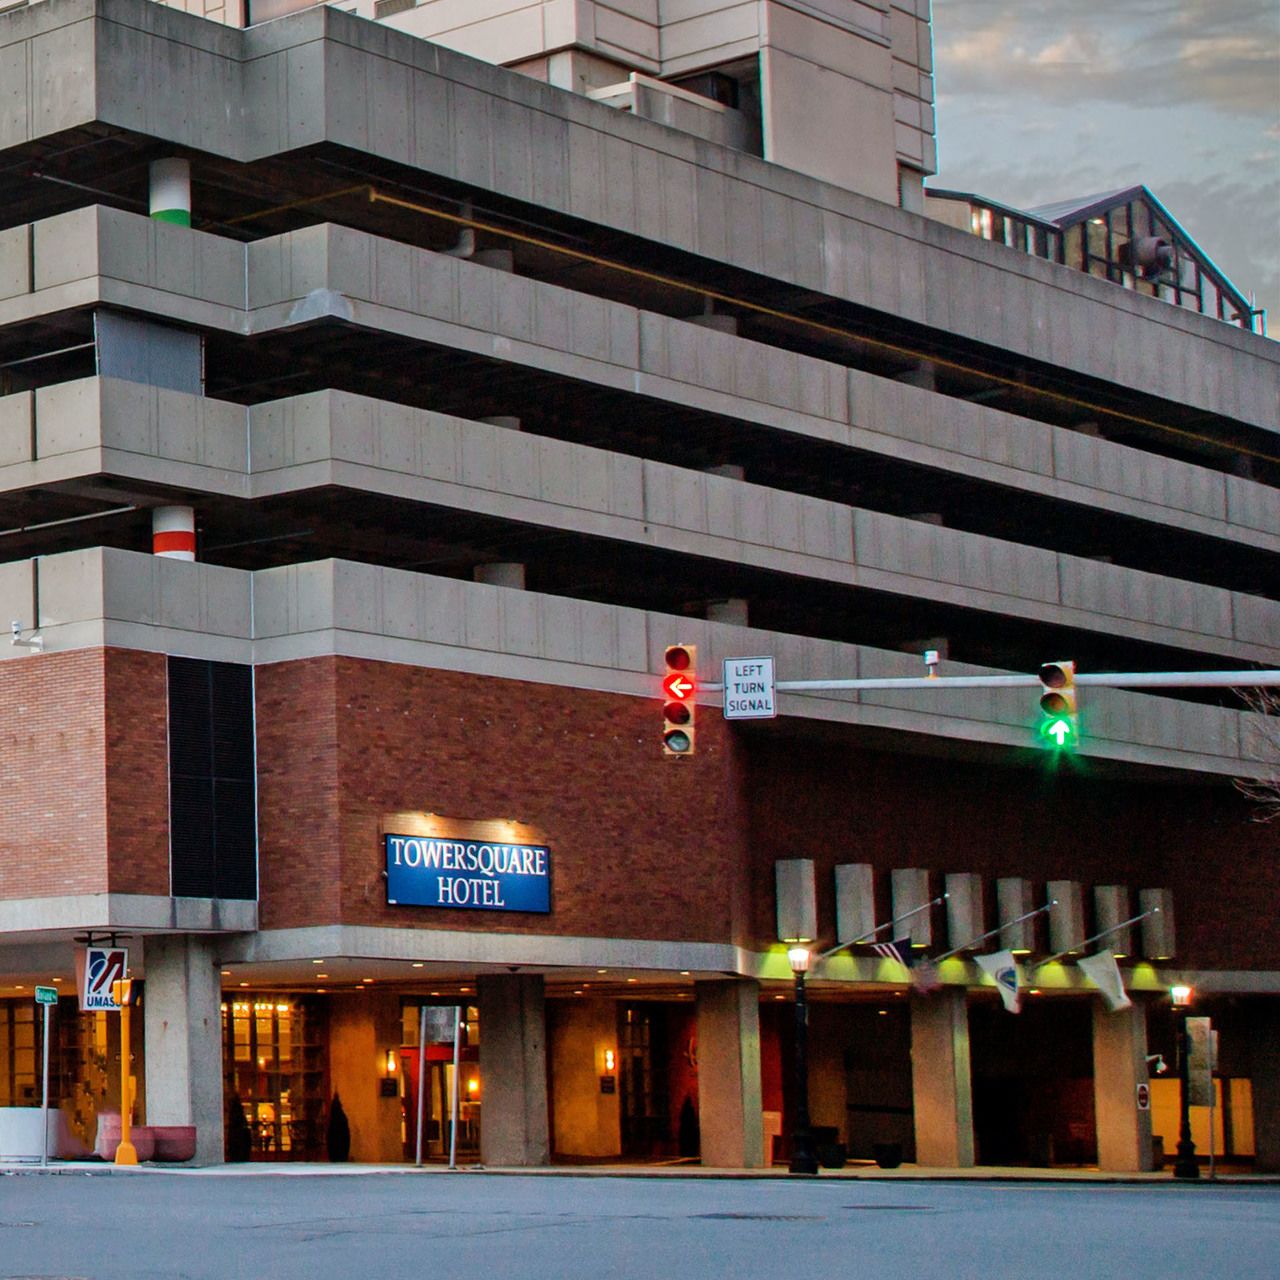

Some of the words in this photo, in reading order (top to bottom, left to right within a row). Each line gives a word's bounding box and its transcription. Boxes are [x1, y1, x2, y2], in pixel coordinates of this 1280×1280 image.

[735, 664, 764, 677] LEFT
[733, 682, 765, 694] TURN
[728, 699, 772, 712] SIGNAL
[390, 837, 546, 877] TOWERSQUARE
[436, 876, 506, 907] HOTEL
[86, 995, 122, 1008] UMAS
